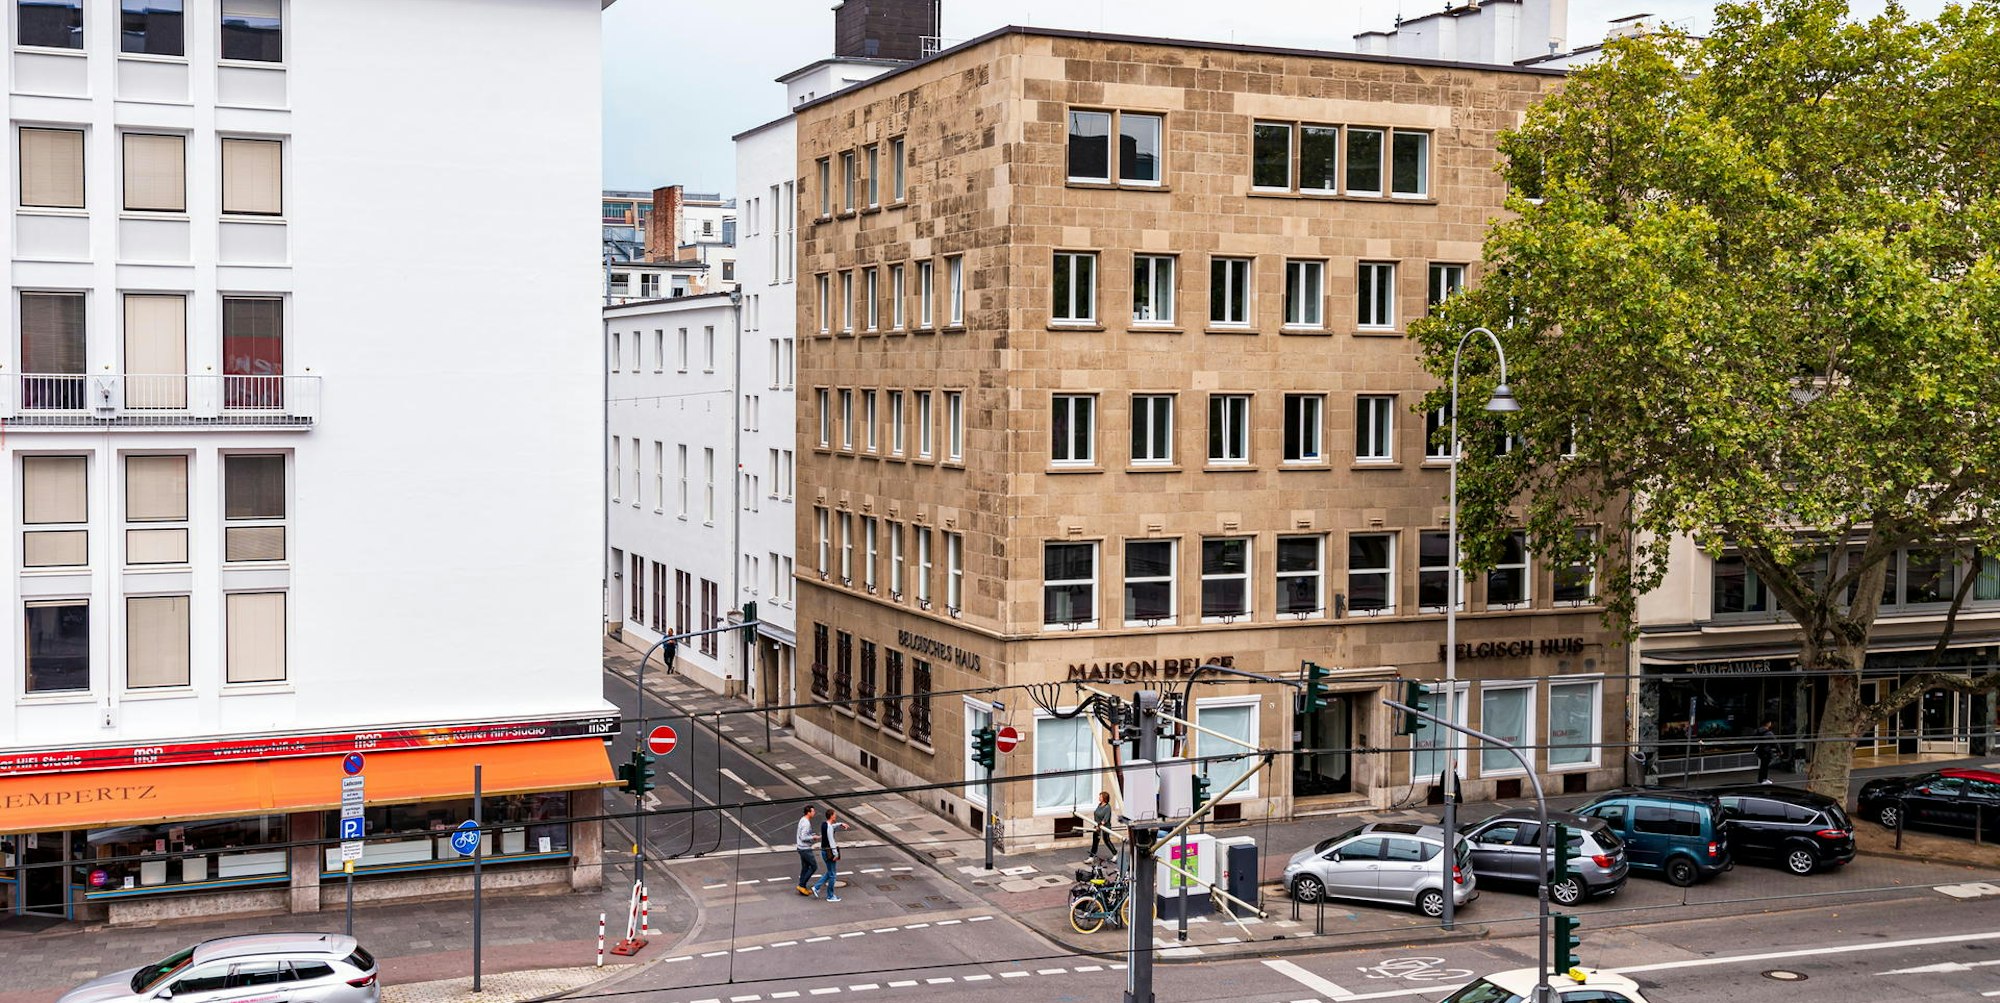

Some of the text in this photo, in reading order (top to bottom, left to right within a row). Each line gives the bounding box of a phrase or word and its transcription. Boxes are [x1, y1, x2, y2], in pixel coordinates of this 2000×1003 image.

[898, 629, 981, 672] BELGISCHES HAUS
[1439, 637, 1584, 661] BELGISCH HUIS
[1067, 659, 1157, 681] MAISON
[0, 785, 157, 809] EMPERTZ
[345, 821, 357, 838] P
